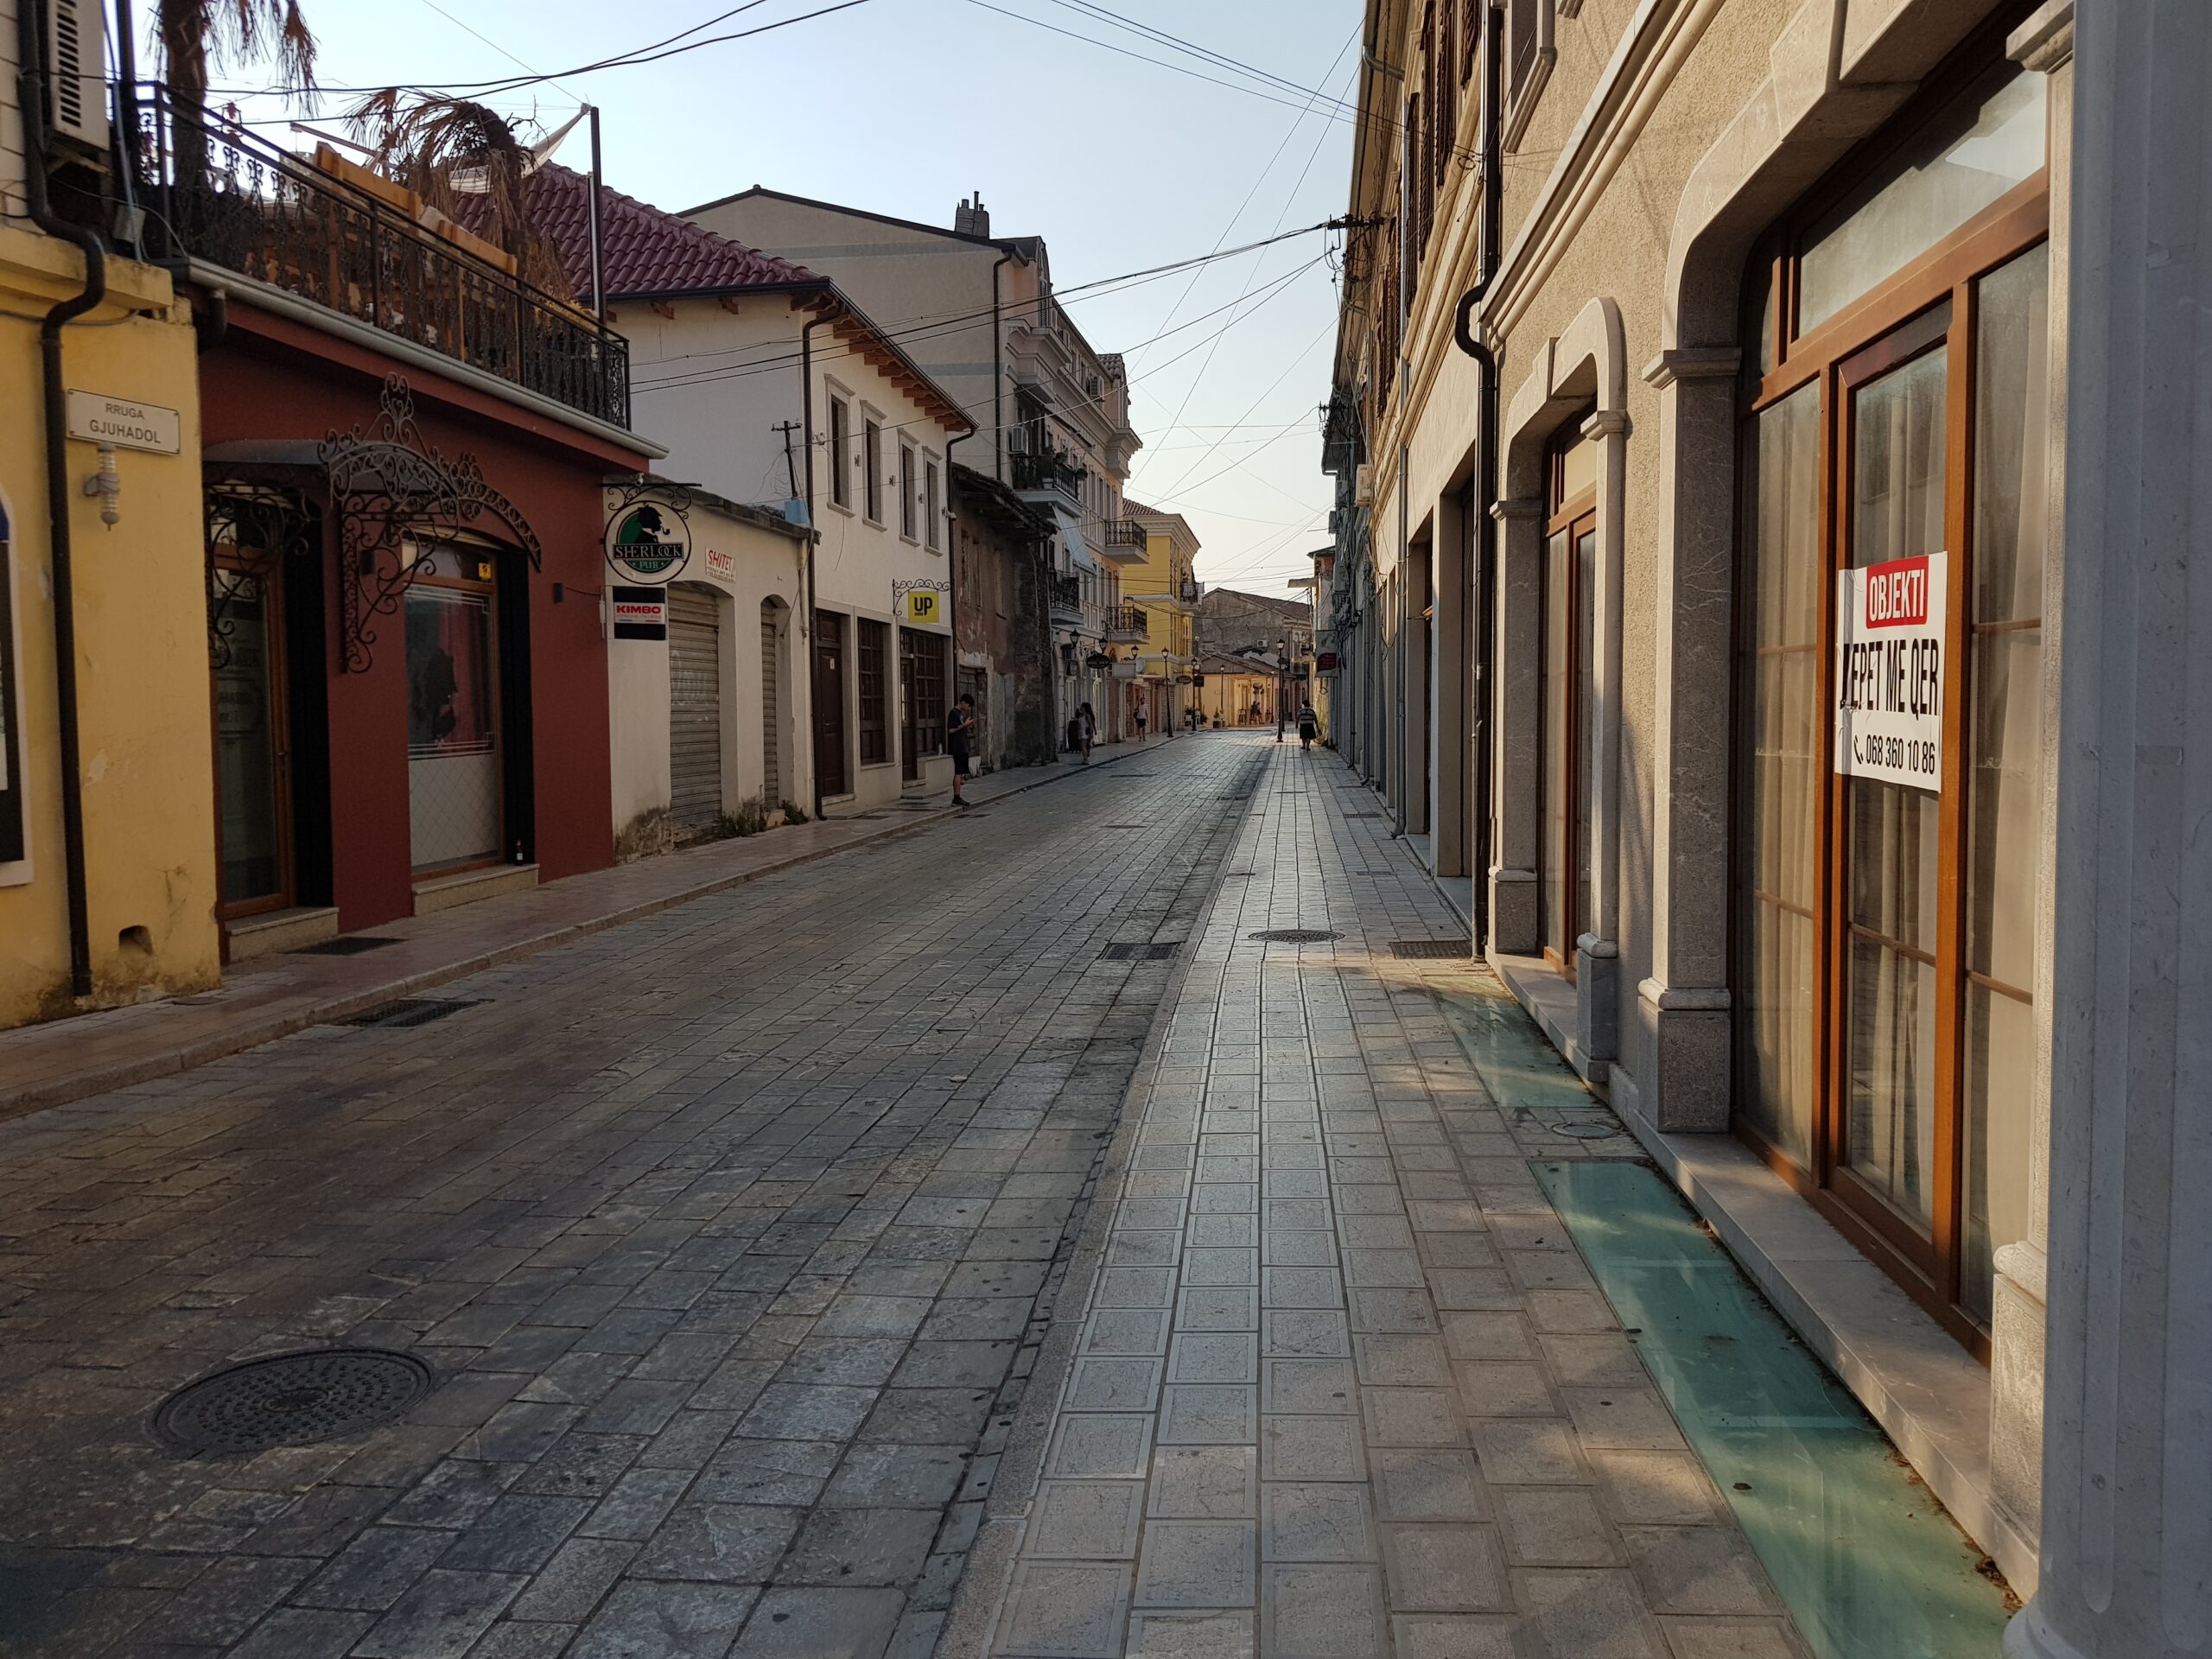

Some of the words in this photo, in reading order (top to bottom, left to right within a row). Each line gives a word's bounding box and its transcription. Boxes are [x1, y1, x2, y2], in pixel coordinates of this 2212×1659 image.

[105, 403, 145, 420] RRUGA
[89, 419, 161, 444] GJUHADOL
[615, 545, 682, 558] SHERLOCK
[639, 561, 658, 569] PUB
[1869, 569, 1925, 622] OBJEKTI
[616, 605, 661, 614] KIMBO
[914, 597, 933, 616] UP
[1885, 639, 1907, 713] ME
[1866, 734, 1884, 766] 068
[1885, 736, 1904, 770] 360
[1907, 739, 1919, 772] 10
[1922, 741, 1936, 775] 86
